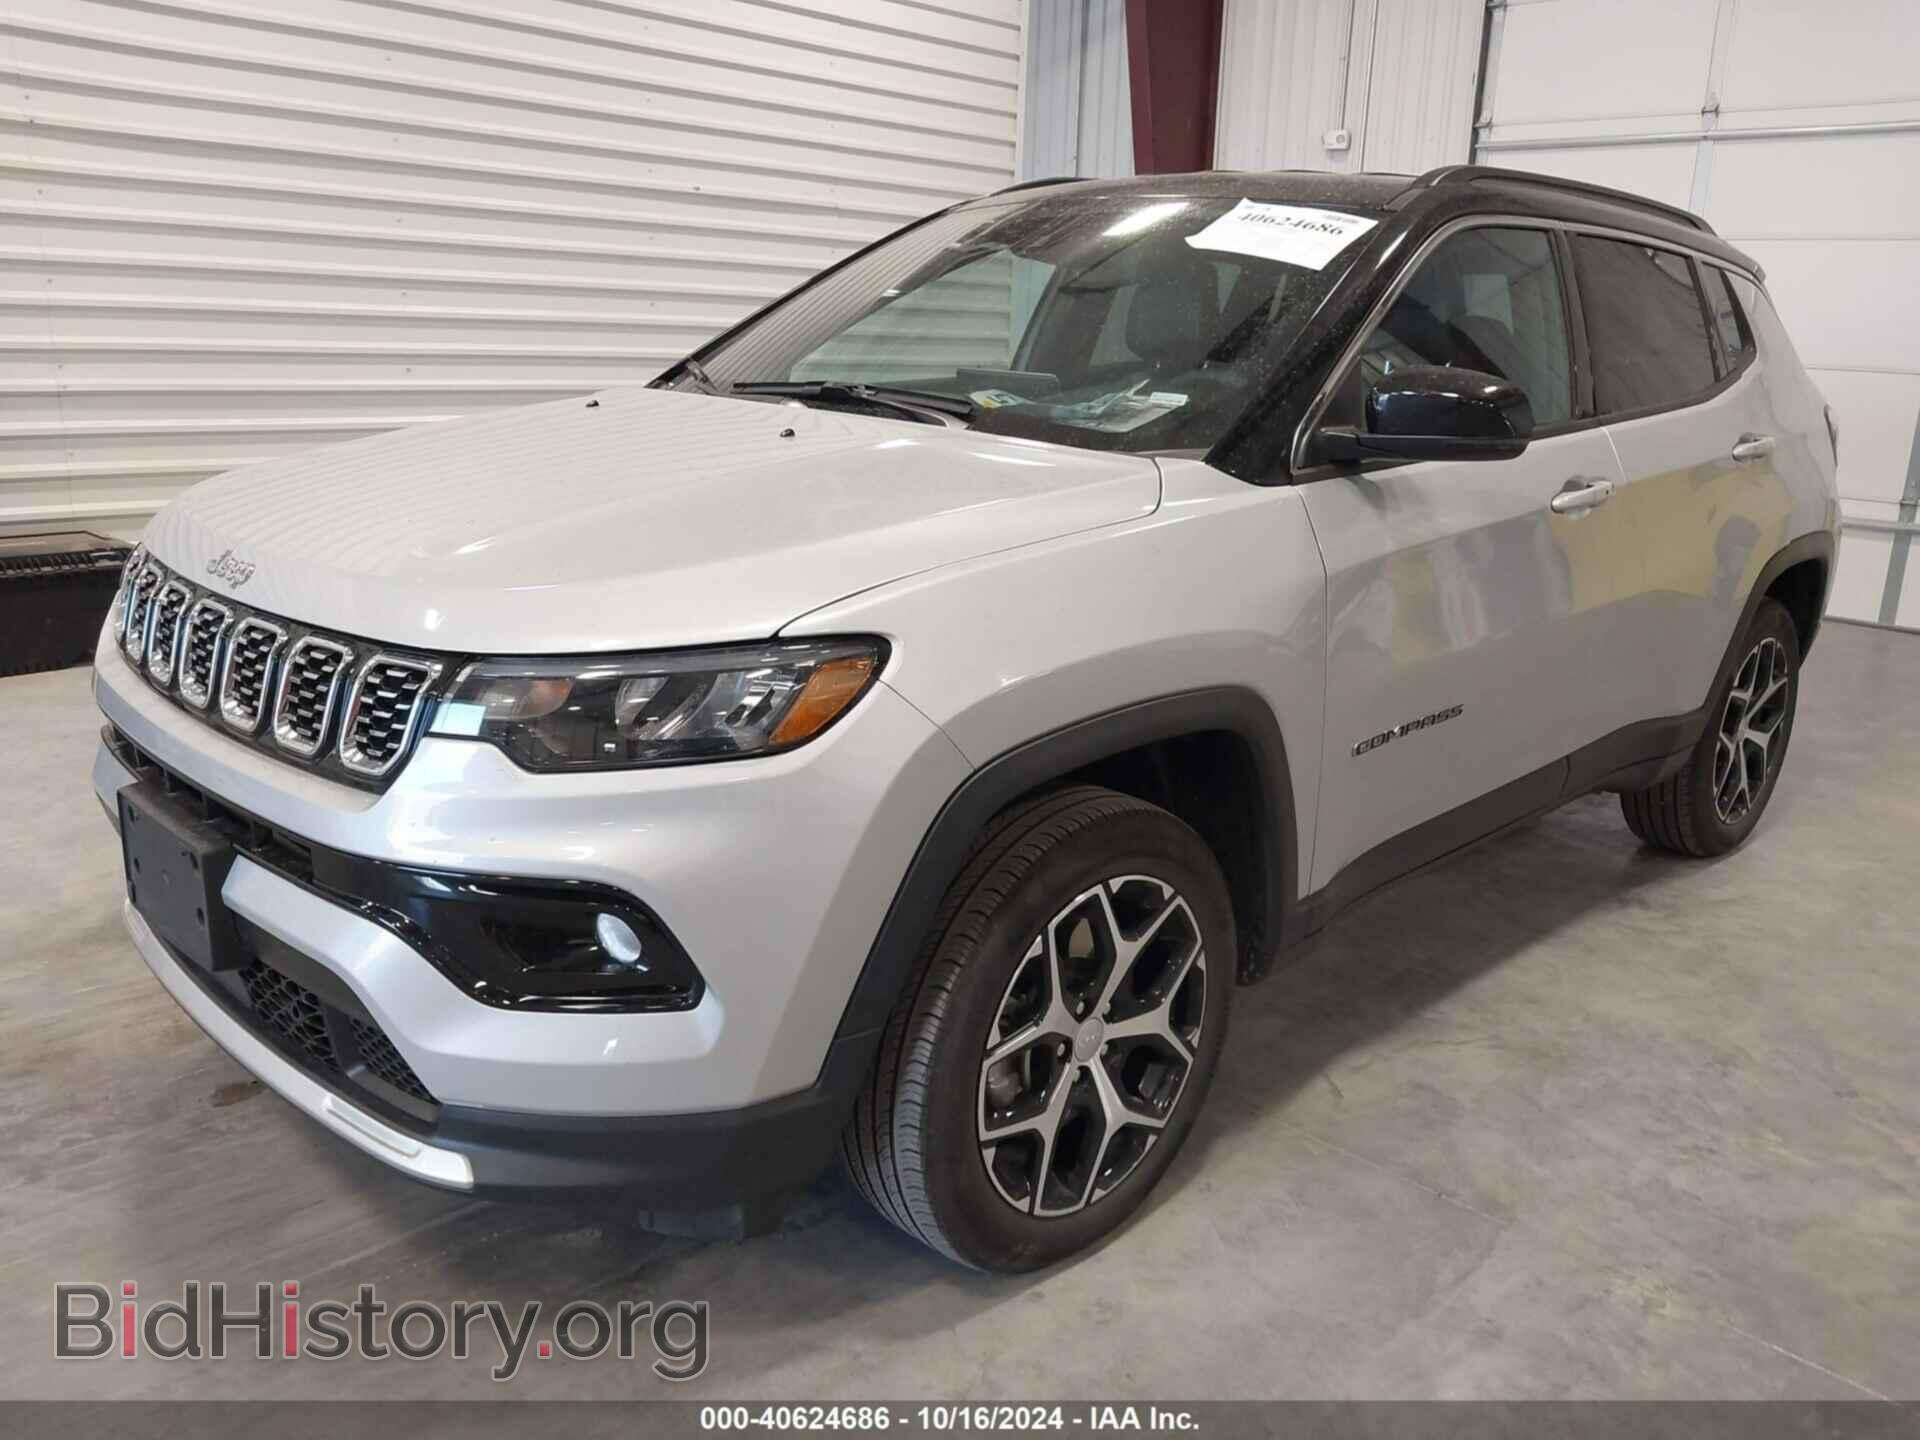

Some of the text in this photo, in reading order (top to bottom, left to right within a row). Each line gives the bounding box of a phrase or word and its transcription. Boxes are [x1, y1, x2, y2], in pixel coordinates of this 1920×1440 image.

[1238, 211, 1344, 236] 40624686
[207, 549, 256, 590] Jeep
[1351, 703, 1465, 758] COMPASS
